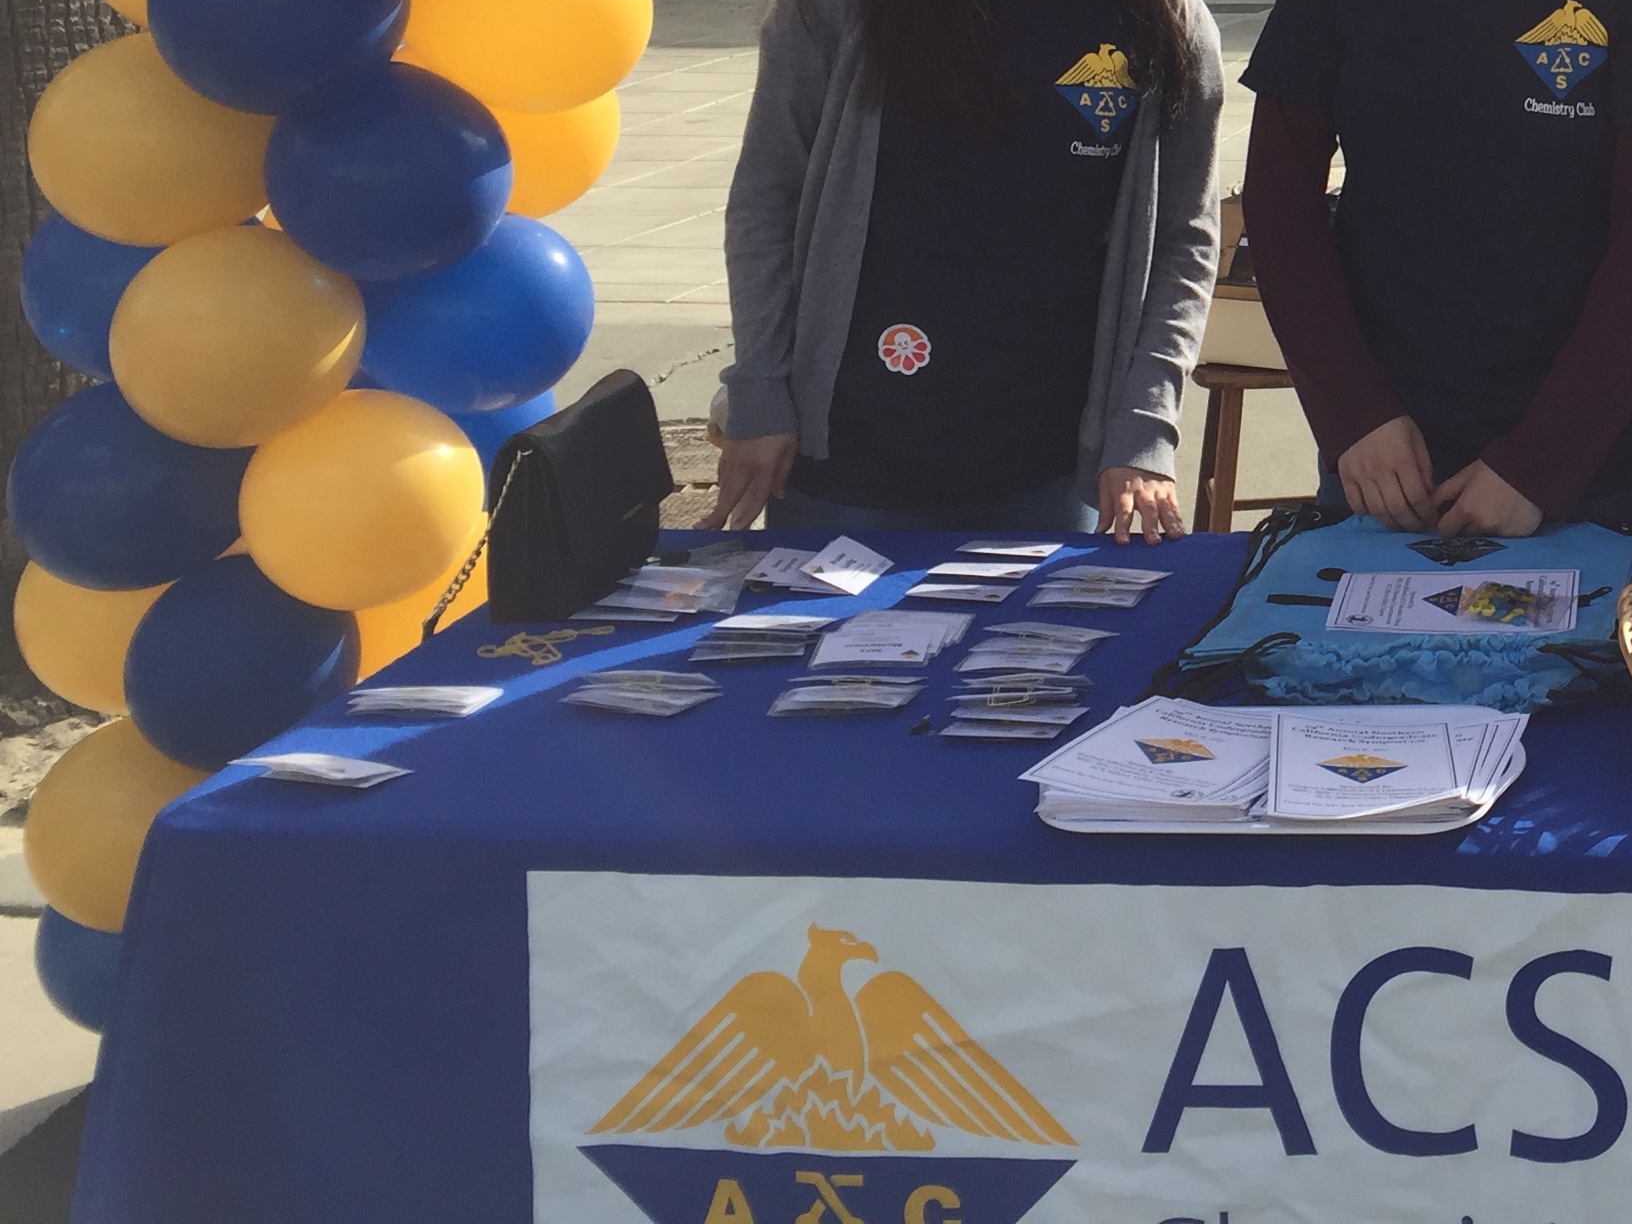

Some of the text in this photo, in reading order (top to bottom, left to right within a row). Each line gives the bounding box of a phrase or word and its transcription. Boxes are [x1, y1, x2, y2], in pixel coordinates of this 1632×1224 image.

[1536, 52, 1590, 66] A C
[1556, 75, 1568, 89] S
[1080, 93, 1127, 109] A C
[1524, 97, 1596, 119] Chemistry Club
[1100, 119, 1110, 133] S
[1142, 946, 1630, 1165] ACS
[704, 1178, 755, 1224] A
